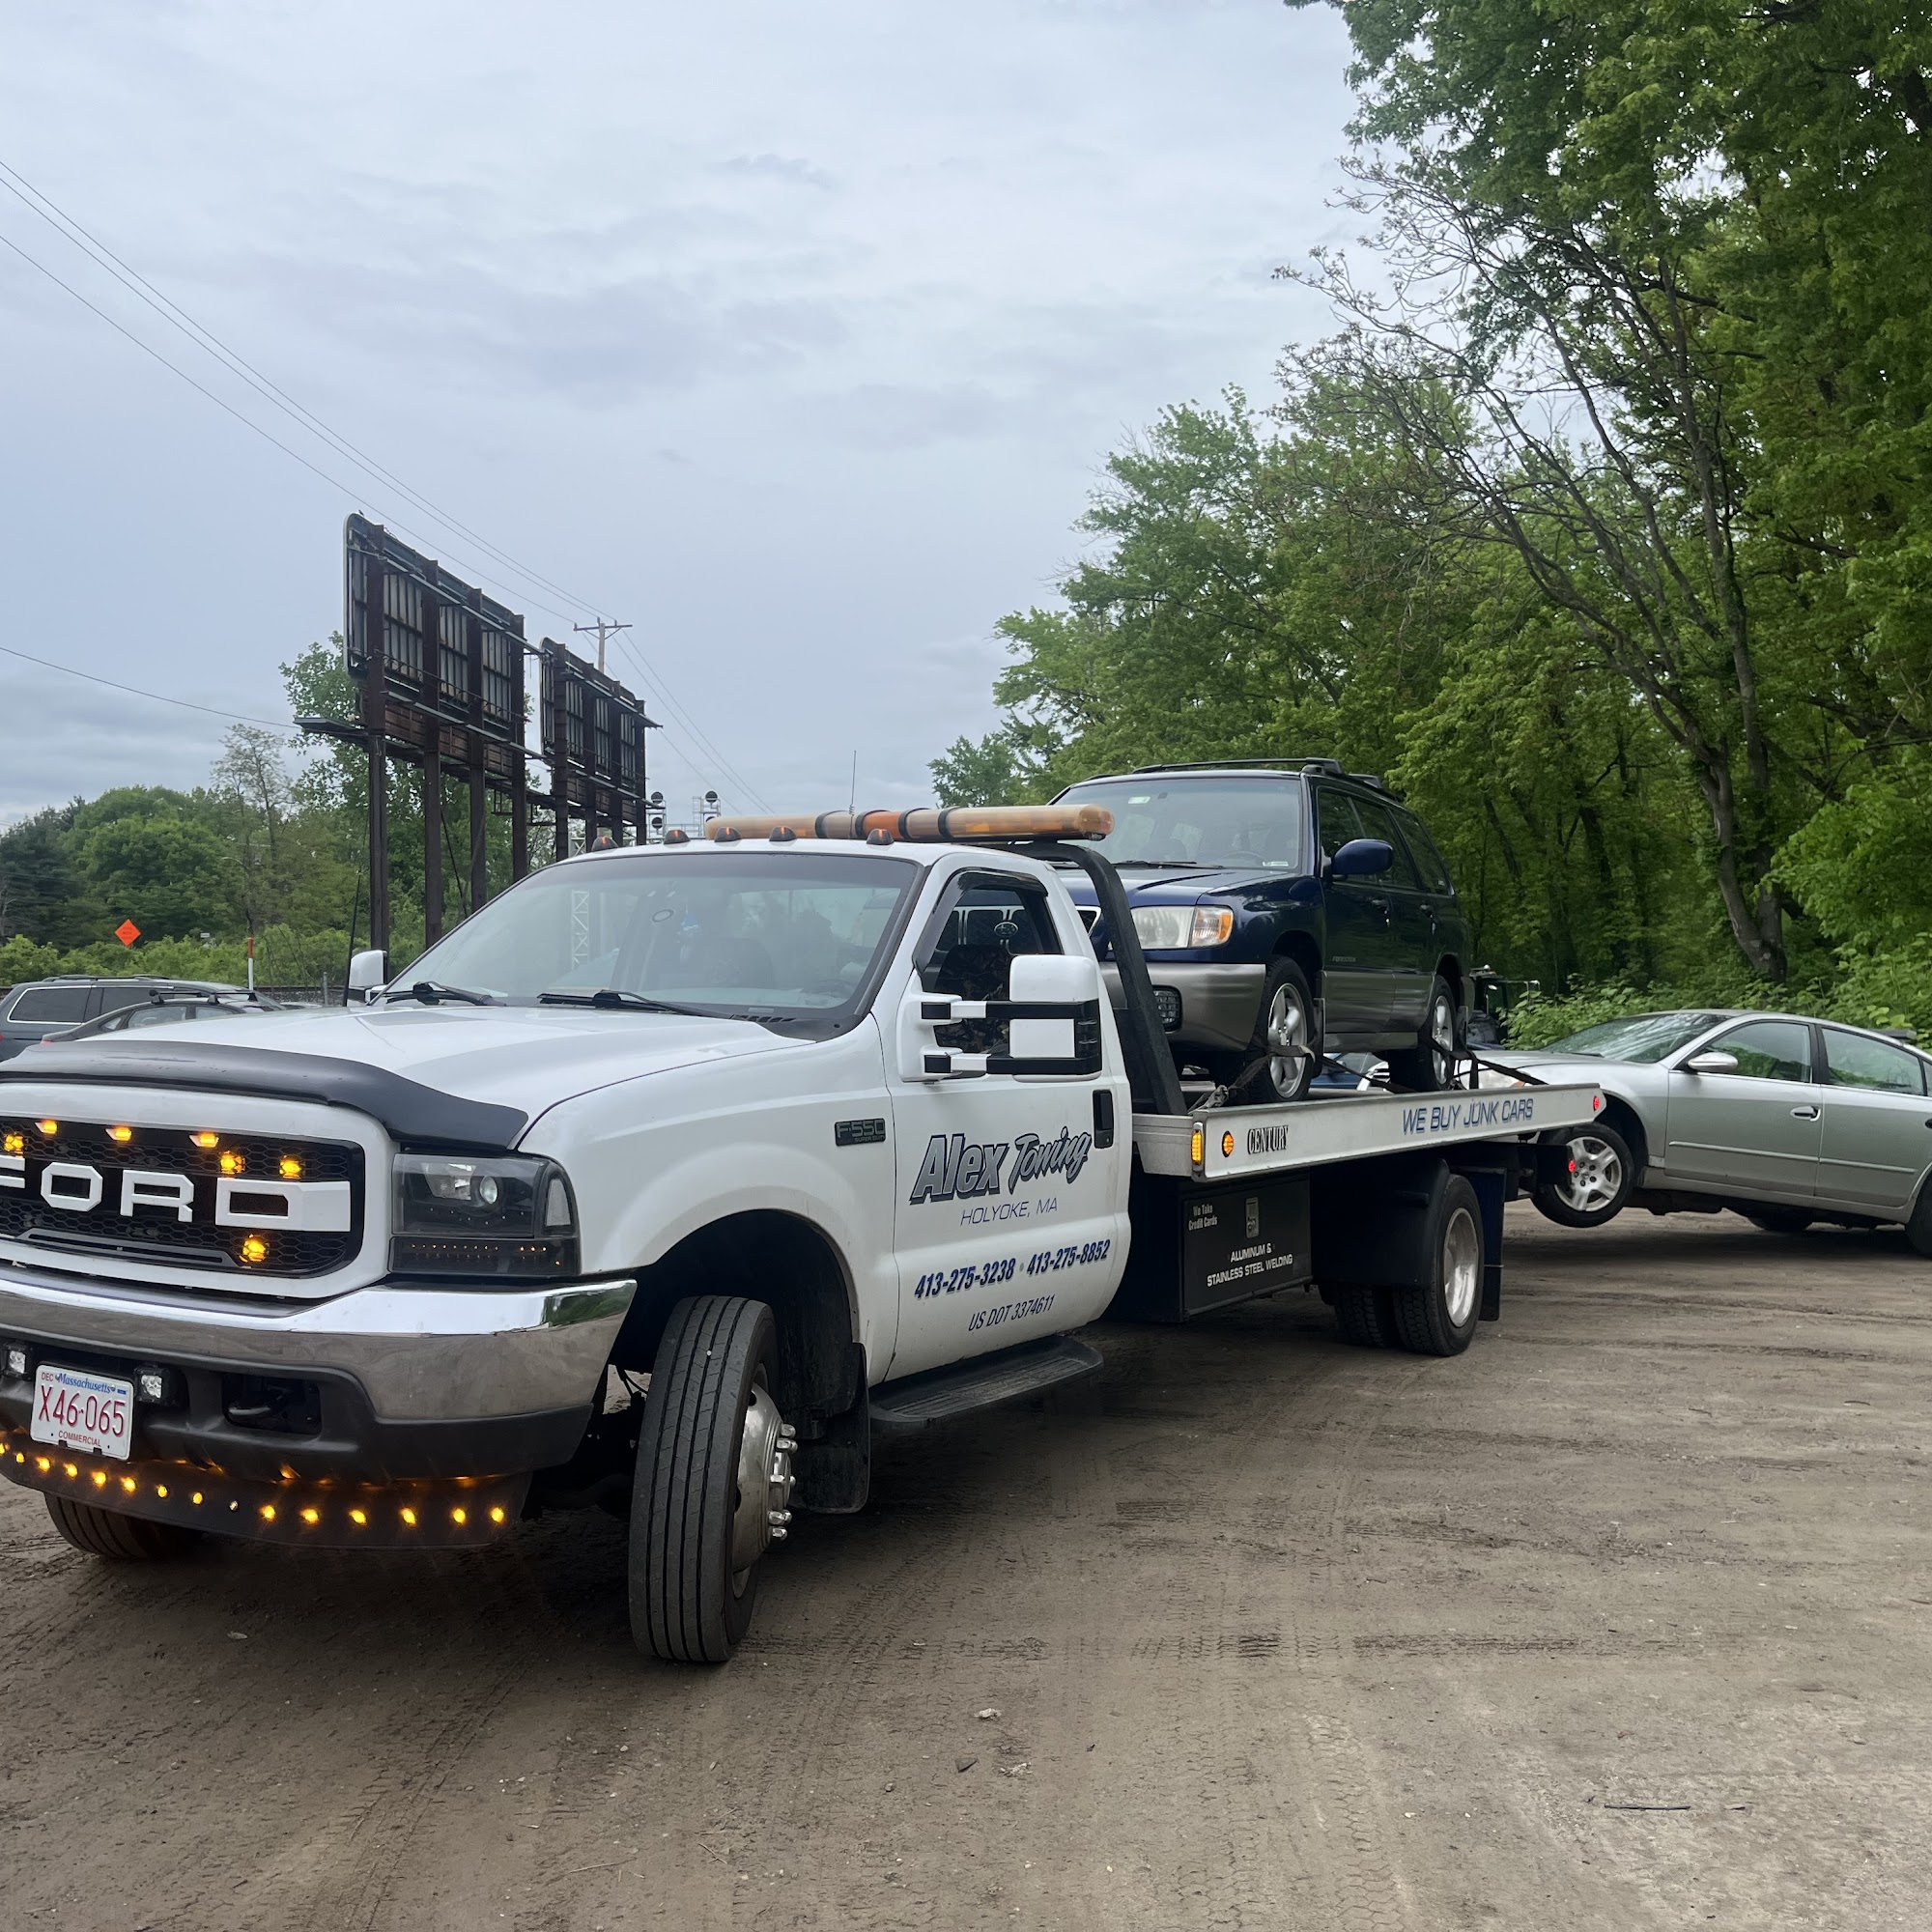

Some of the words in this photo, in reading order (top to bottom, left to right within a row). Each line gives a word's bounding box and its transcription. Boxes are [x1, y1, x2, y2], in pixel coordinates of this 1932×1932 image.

[1403, 1108, 1427, 1135] WE
[1431, 1105, 1462, 1132] BUY
[1463, 1101, 1499, 1128] JUNK
[1501, 1098, 1534, 1123] CARS
[1247, 1125, 1289, 1154] CENTURY
[910, 1133, 1010, 1205] Alex
[1008, 1126, 1093, 1195] Towing
[960, 1201, 1031, 1226] HOLYOKE,
[1037, 1197, 1058, 1214] MA
[1202, 1204, 1213, 1214] Take
[1204, 1215, 1218, 1227] Cards
[1230, 1244, 1265, 1263] ALUMINUM
[914, 1258, 1016, 1300] 413-275-3238
[1027, 1238, 1111, 1276] 413-275-8852
[1207, 1266, 1243, 1287] STAINLESS
[1244, 1262, 1264, 1276] STEEL
[1265, 1254, 1293, 1270] WELDING
[968, 1311, 986, 1331] US
[986, 1304, 1012, 1326] DOT
[1011, 1294, 1055, 1321] 3374611
[41, 1372, 54, 1381] DEC
[58, 1373, 112, 1394] Massachusetts
[58, 1431, 101, 1447] COMMERCIAL
